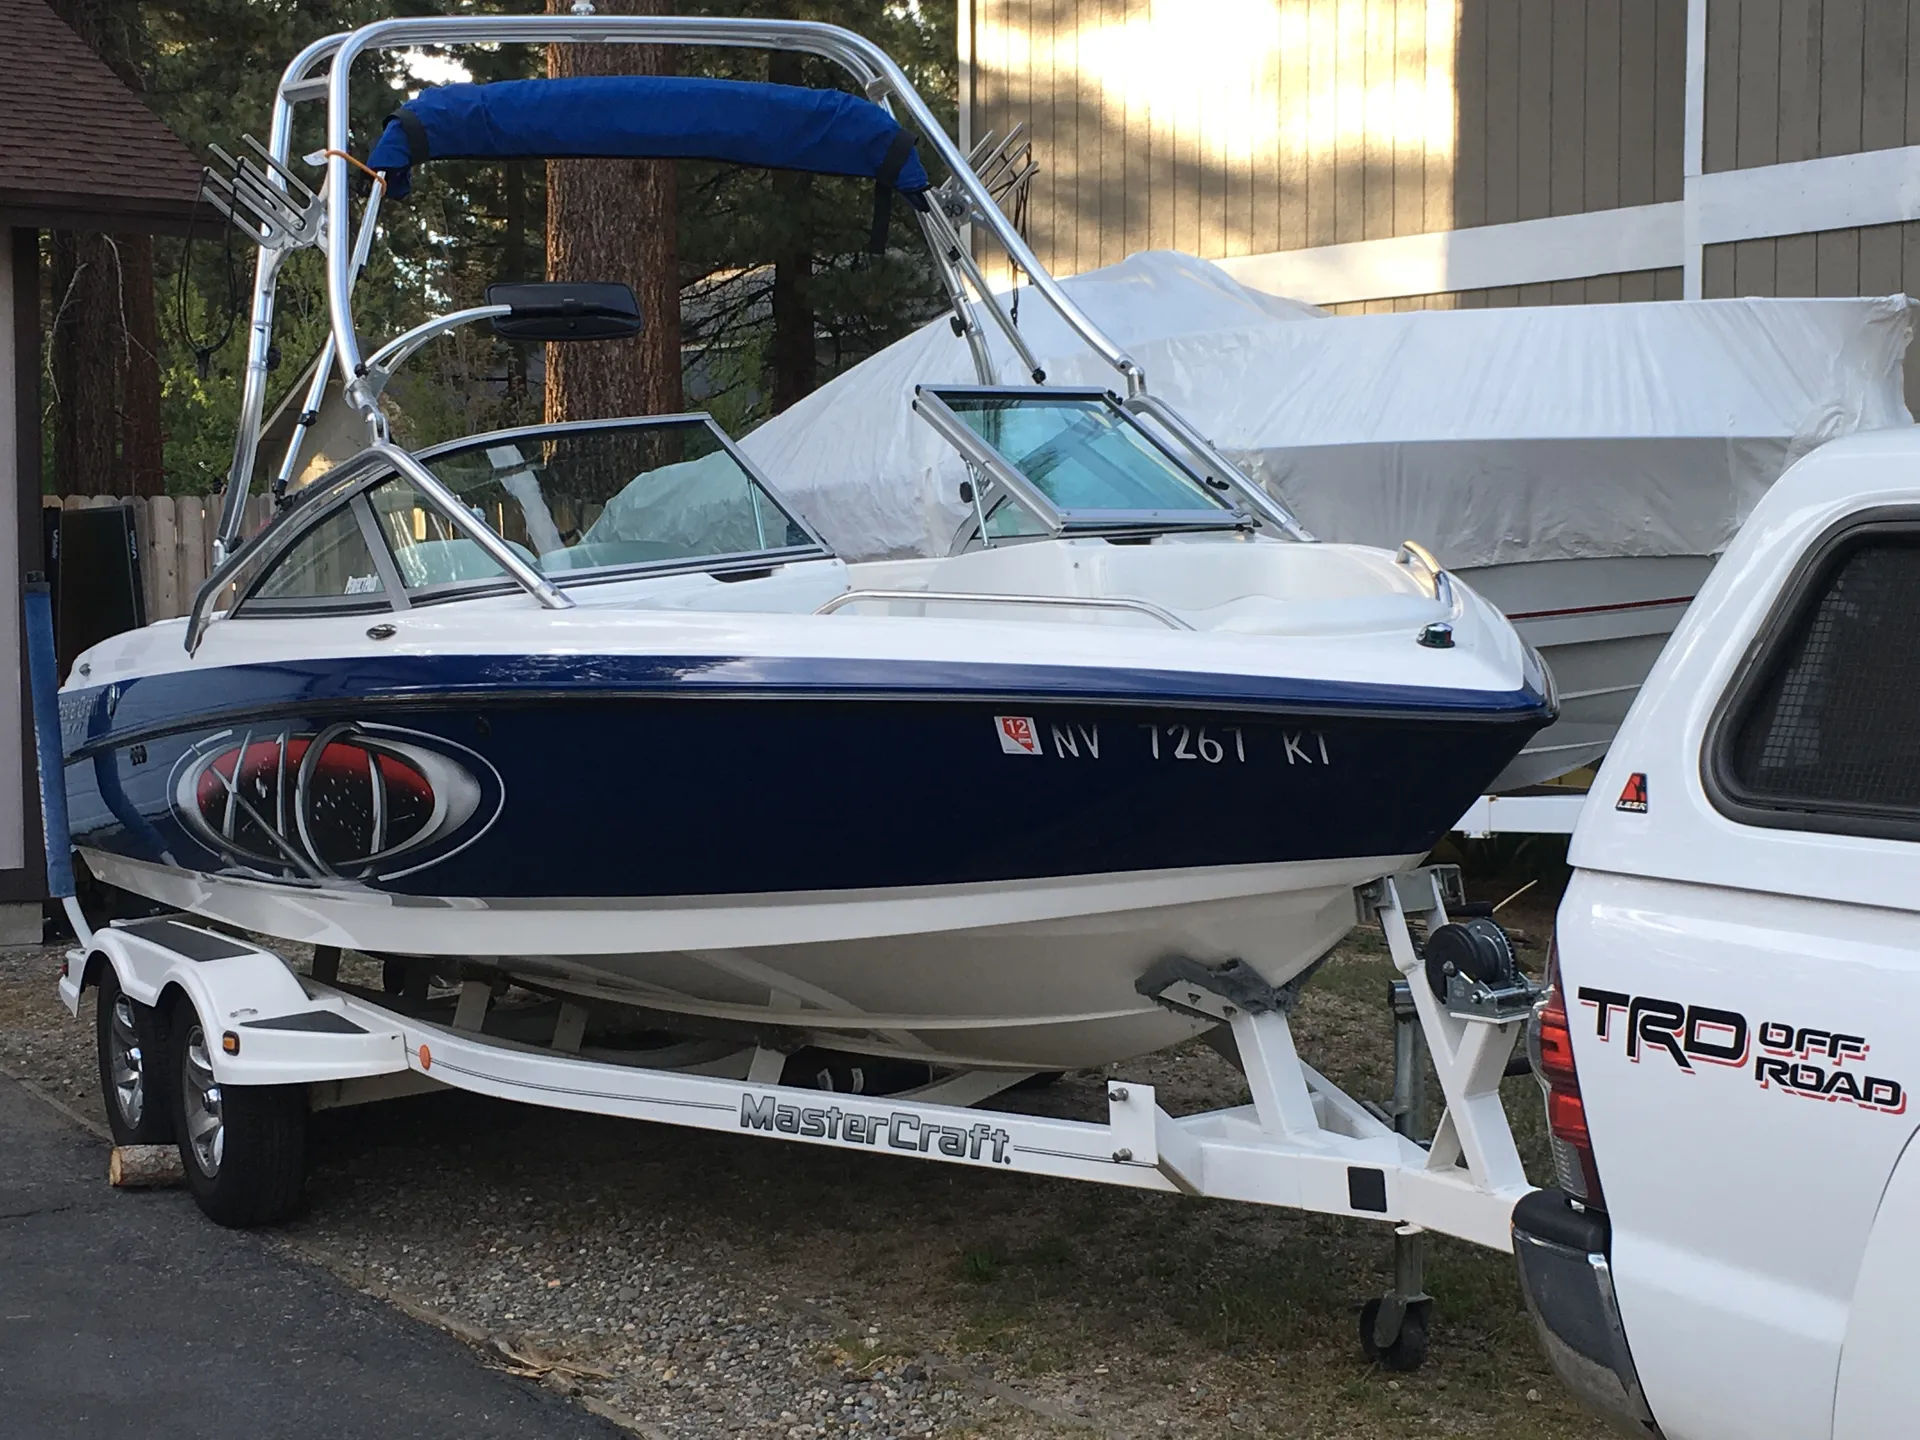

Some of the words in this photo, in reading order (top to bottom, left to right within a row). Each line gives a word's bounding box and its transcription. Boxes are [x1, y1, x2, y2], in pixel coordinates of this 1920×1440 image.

[1006, 719, 1029, 734] 12
[1050, 722, 1099, 759] NV
[1138, 723, 1245, 764] 7267
[1282, 729, 1330, 765] KT
[1577, 986, 1750, 1075] TRD
[1758, 1021, 1870, 1066] OFF
[1754, 1056, 1906, 1115] ROAD
[740, 1092, 1010, 1164] MasterCraft
